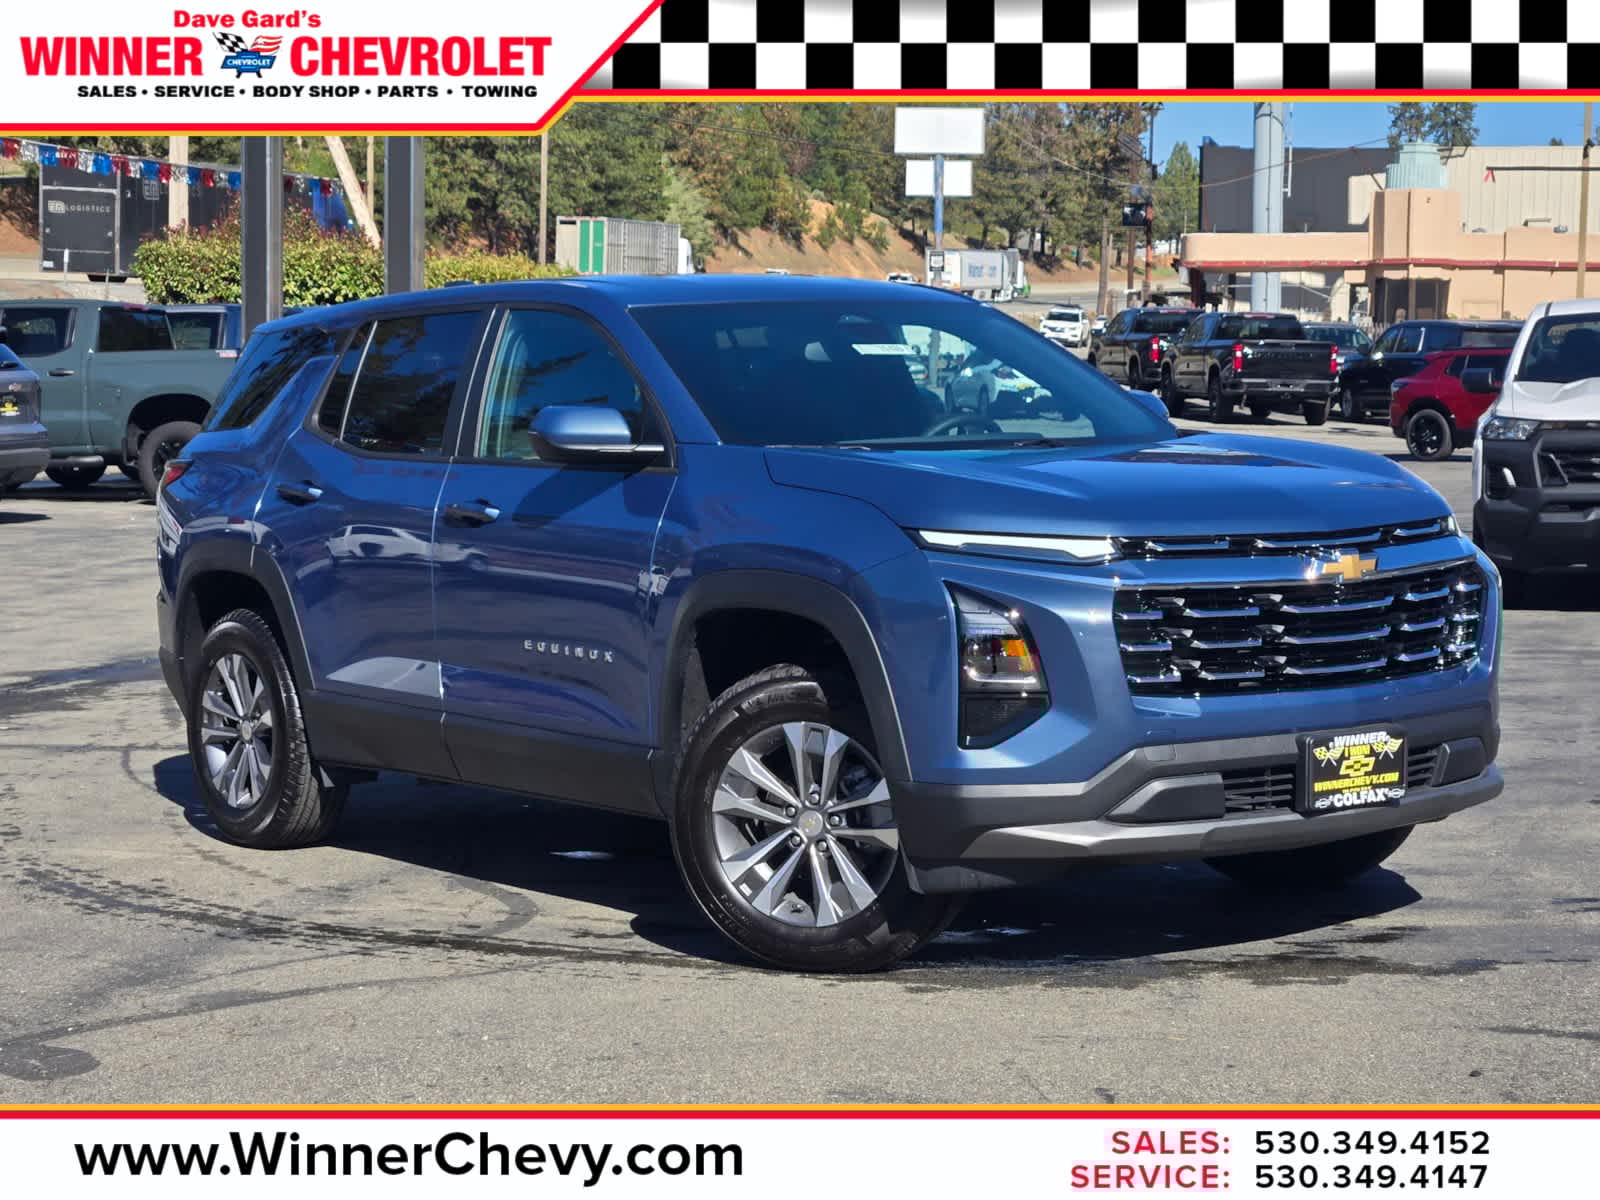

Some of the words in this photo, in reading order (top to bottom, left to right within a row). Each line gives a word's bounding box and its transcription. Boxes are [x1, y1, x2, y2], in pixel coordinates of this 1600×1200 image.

[523, 639, 613, 663] EQUINOX
[1333, 732, 1387, 748] WINNER
[1314, 772, 1400, 792] WINNERCHEVY.COM
